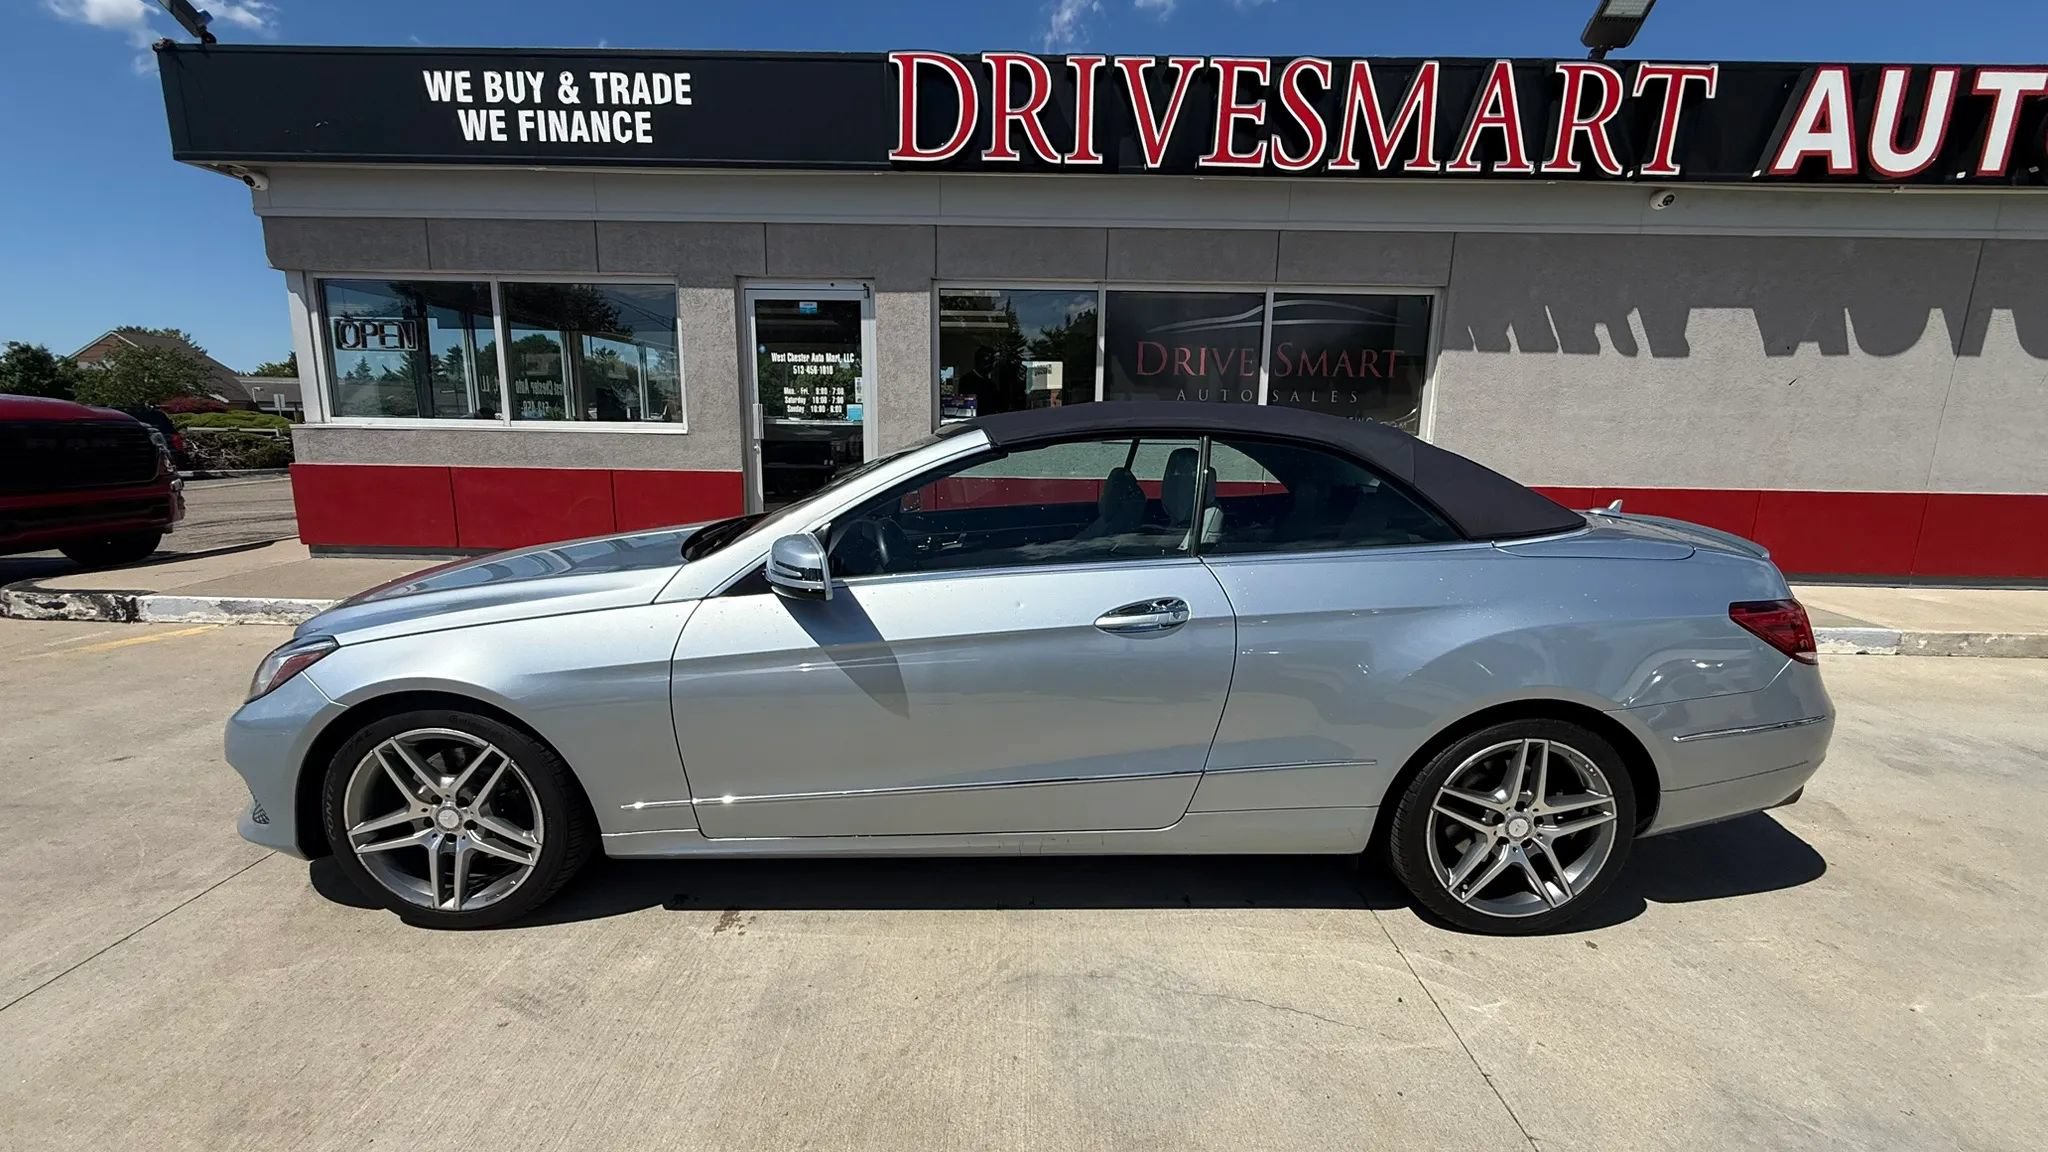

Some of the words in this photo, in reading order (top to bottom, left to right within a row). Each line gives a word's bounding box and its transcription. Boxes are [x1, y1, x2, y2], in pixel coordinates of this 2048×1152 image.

[423, 70, 473, 102] WE
[483, 71, 545, 104] BUY
[558, 71, 581, 104] &
[590, 72, 692, 105] TRADE
[889, 50, 1718, 175] DRIVESMART
[1768, 64, 2048, 179] AUT
[457, 109, 508, 141] WE
[518, 110, 653, 143] FINANCE
[339, 320, 415, 350] OPEN
[771, 352, 786, 362] West
[787, 352, 810, 362] Chester
[811, 352, 824, 362] Auto
[843, 353, 855, 363] LLC
[784, 396, 806, 405] Saturday
[1176, 389, 1253, 401] AUTO
[1272, 389, 1358, 403] SALES
[787, 404, 805, 414] Sunday
